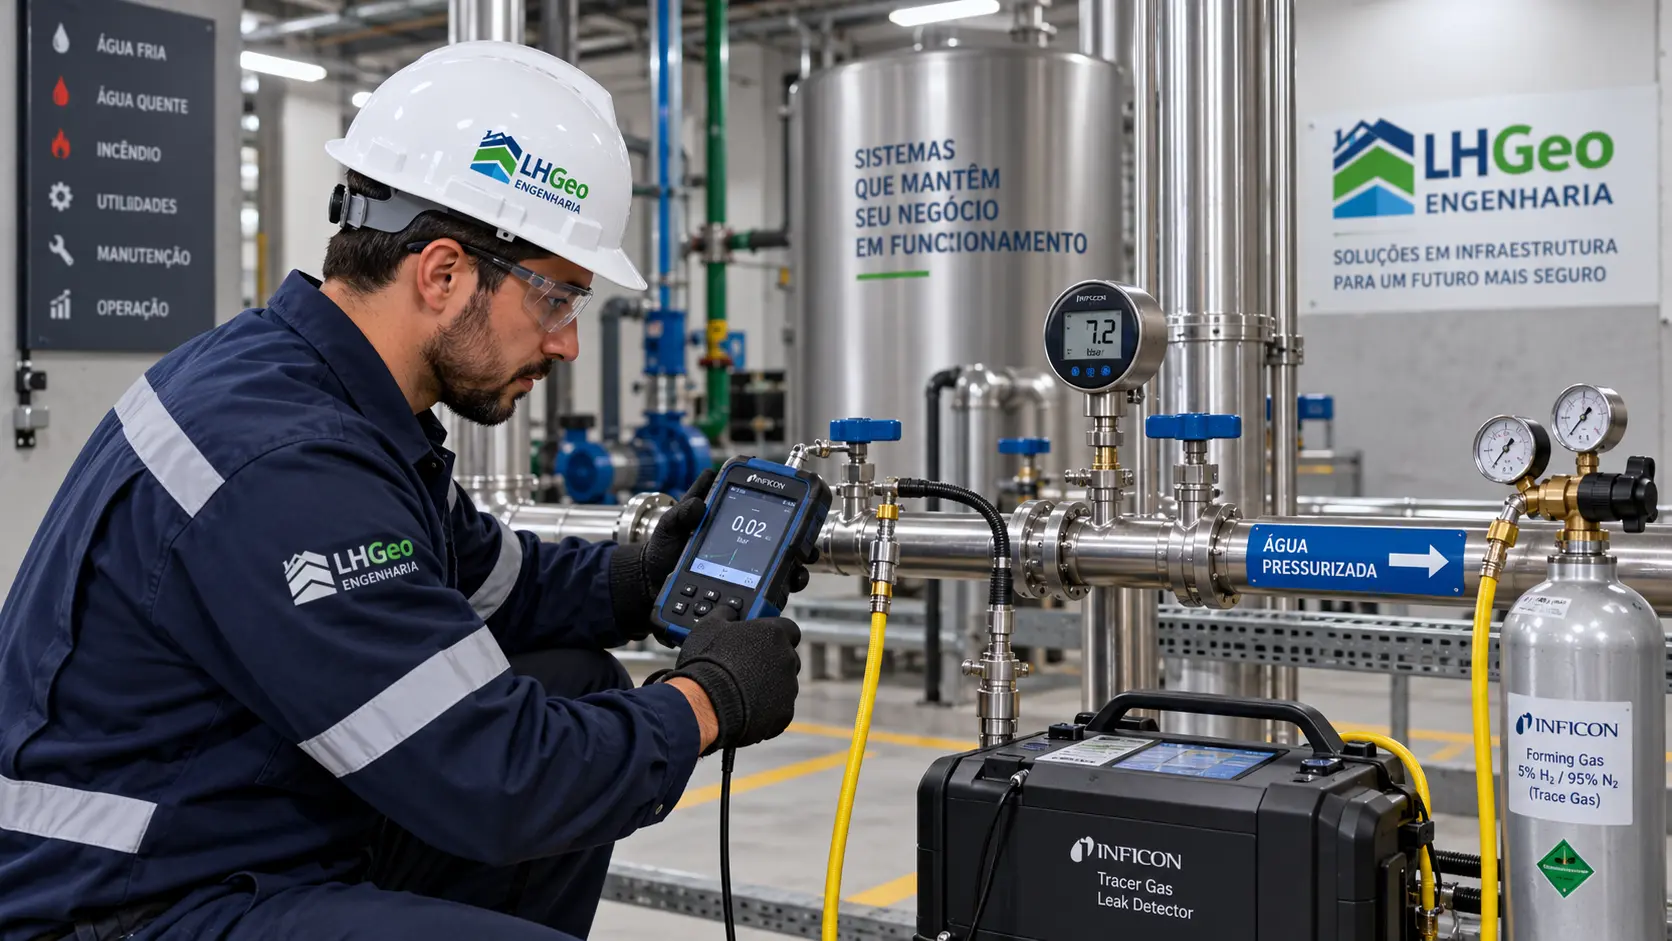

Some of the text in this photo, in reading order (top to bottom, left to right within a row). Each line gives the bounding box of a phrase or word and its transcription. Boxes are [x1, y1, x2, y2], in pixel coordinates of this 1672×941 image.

[96, 33, 167, 61] ÁGUA FRIA
[96, 86, 189, 114] ÁGUA QUENTE
[97, 141, 162, 163] INCÊNDIO
[855, 139, 956, 169] SISTEMAS
[1425, 124, 1615, 180] LHGeo
[519, 153, 589, 200] LHGeo
[855, 163, 1000, 201] QUE MANTÊM
[514, 179, 581, 215] ENGENHARIA
[1425, 183, 1615, 214] ENGENHARIA
[855, 195, 1000, 228] SEU NEGÓCIO
[97, 245, 191, 268] MANUTENÇÃO
[856, 236, 884, 258] EM
[1333, 238, 1618, 267] SOLUÇÕES EM INFRAESTRUTURA
[1333, 265, 1607, 290] PARA UM FUTURO MAIS SEGURO
[97, 297, 169, 320] OPERAÇÃO
[1086, 319, 1116, 345] 7.2
[731, 515, 767, 538] 0.02
[333, 539, 414, 575] LHGeo
[1263, 534, 1308, 554] ÁGUA
[341, 561, 419, 591] ENGENHARIA
[1262, 559, 1378, 579] PRESSURIZADA
[1536, 718, 1619, 738] INFICON
[1526, 748, 1604, 767] Forming Gas
[1518, 765, 1536, 779] 5%
[1568, 771, 1598, 786] 95%
[1529, 786, 1601, 808] (Trace Gas)
[1097, 843, 1182, 870] INFICON
[1097, 871, 1173, 896] Tracer Gas
[1097, 892, 1194, 920] Leak Detector
